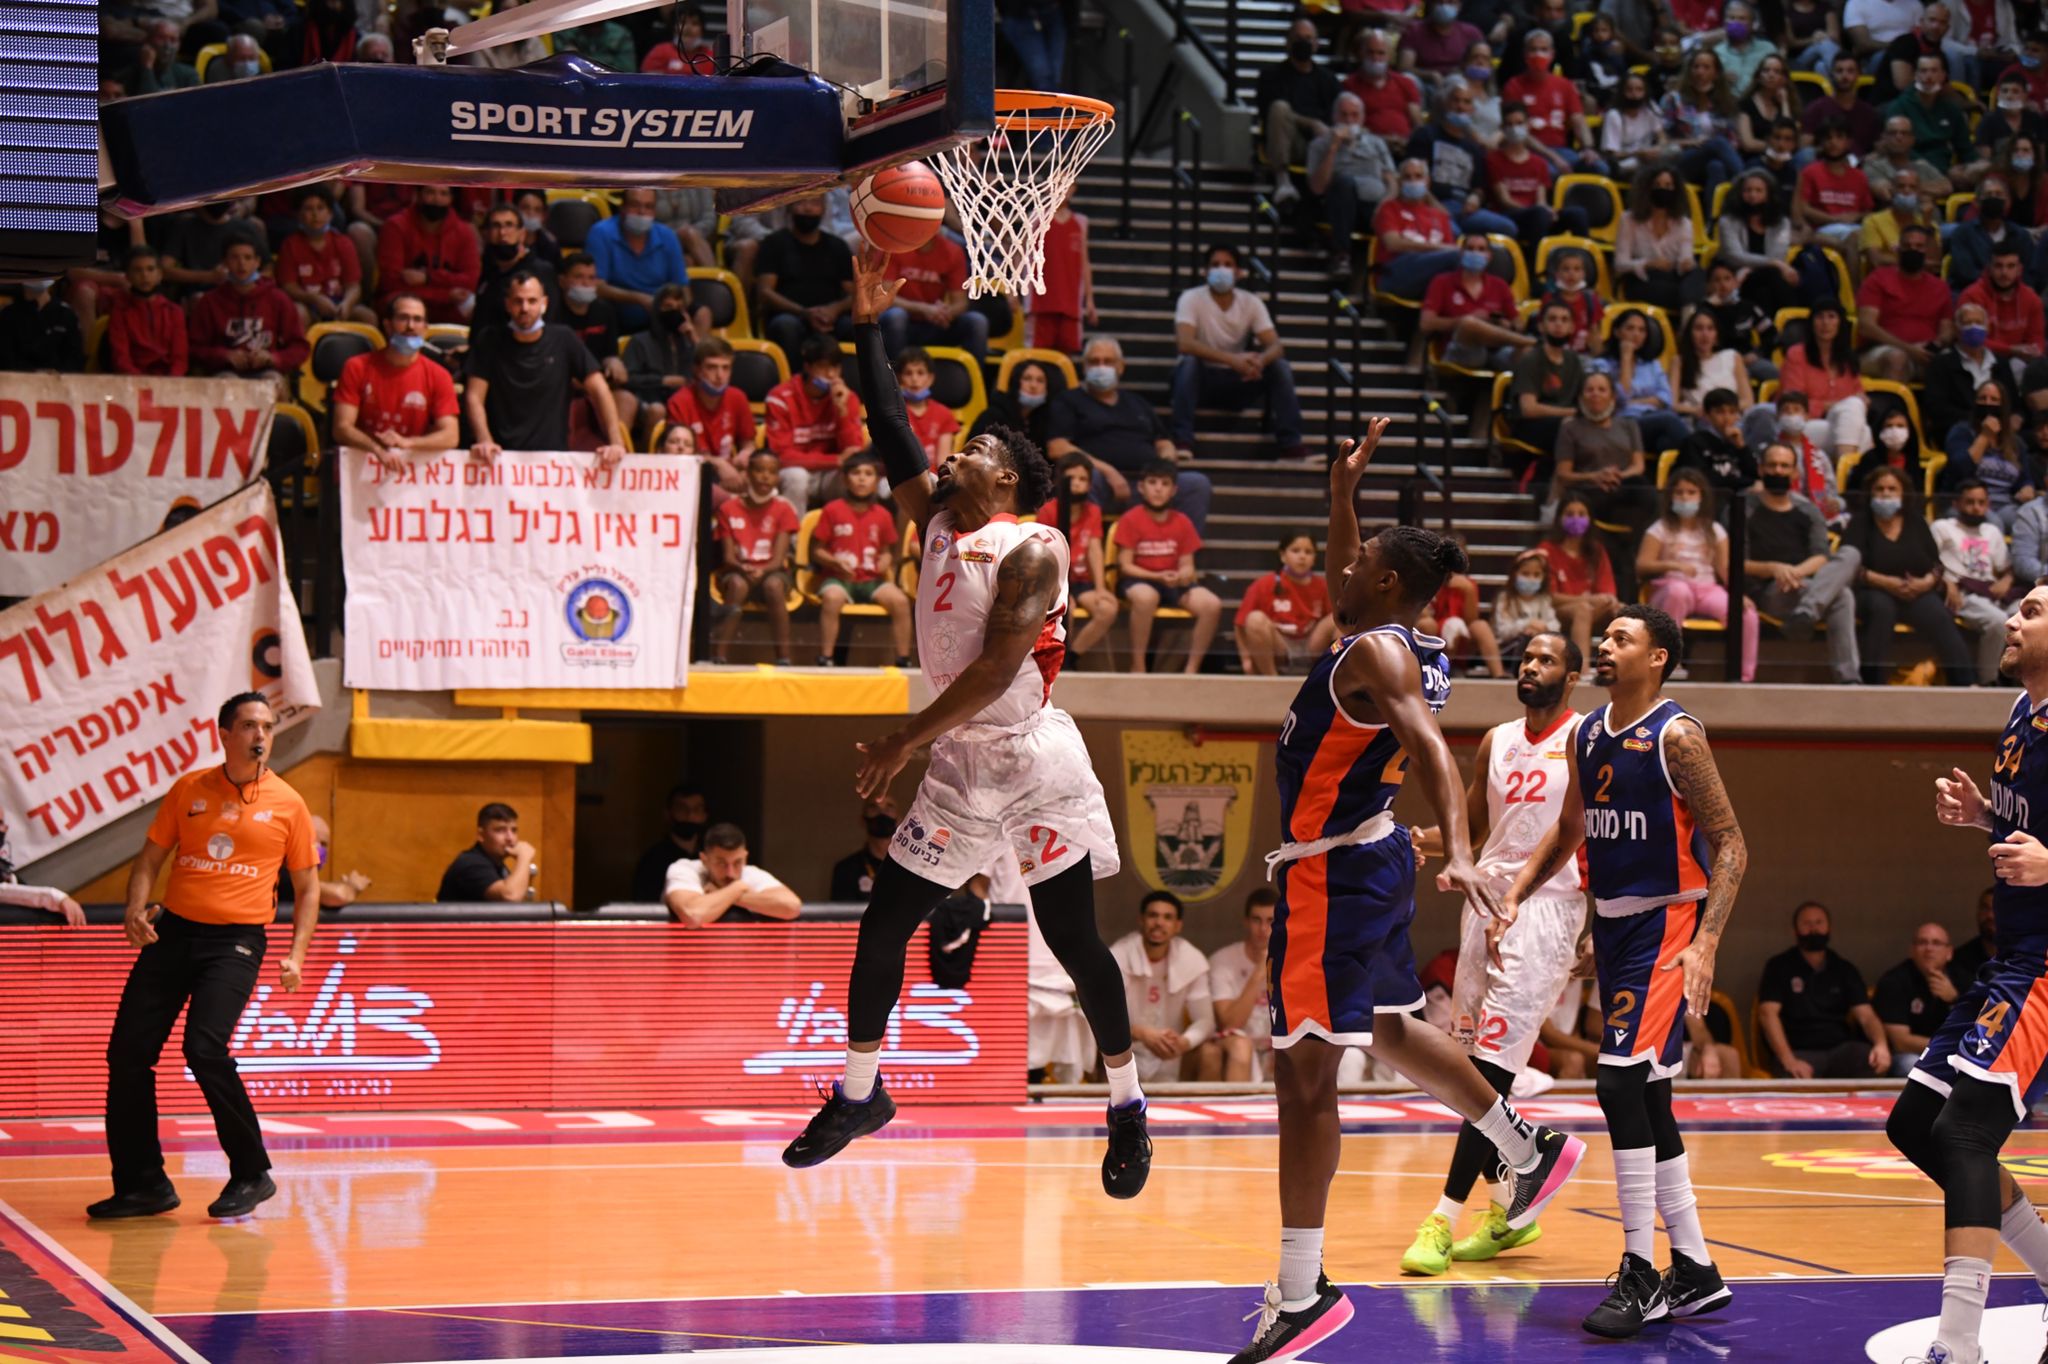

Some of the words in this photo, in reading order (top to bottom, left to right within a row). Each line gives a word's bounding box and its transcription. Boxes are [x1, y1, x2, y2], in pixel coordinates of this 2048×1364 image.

[451, 101, 587, 135] SPORT
[591, 108, 754, 147] SYSTEM
[425, 459, 454, 485] לא
[512, 460, 576, 488] גלבוע
[583, 464, 612, 489] לא
[620, 468, 679, 491] אנחנו
[368, 499, 495, 543] בגלבוע
[509, 500, 582, 543] גליל
[594, 512, 637, 552] אין
[651, 513, 680, 548] כי
[107, 514, 279, 643] הפועל
[933, 572, 956, 612] 2
[378, 638, 462, 662] מחיקויים
[468, 638, 530, 658] היזהרו
[13, 673, 186, 782] אימפריה
[102, 716, 223, 803] לעולם
[1994, 735, 2025, 780] 34
[1505, 770, 1547, 804] 22
[1595, 764, 1613, 802] 2
[26, 781, 104, 837] ועד
[1624, 810, 1647, 840] חי
[909, 843, 940, 866] כביש
[1030, 825, 1068, 864] 2
[229, 863, 258, 878] בנק
[1149, 986, 1161, 1003] 5
[1607, 990, 1635, 1029] 2
